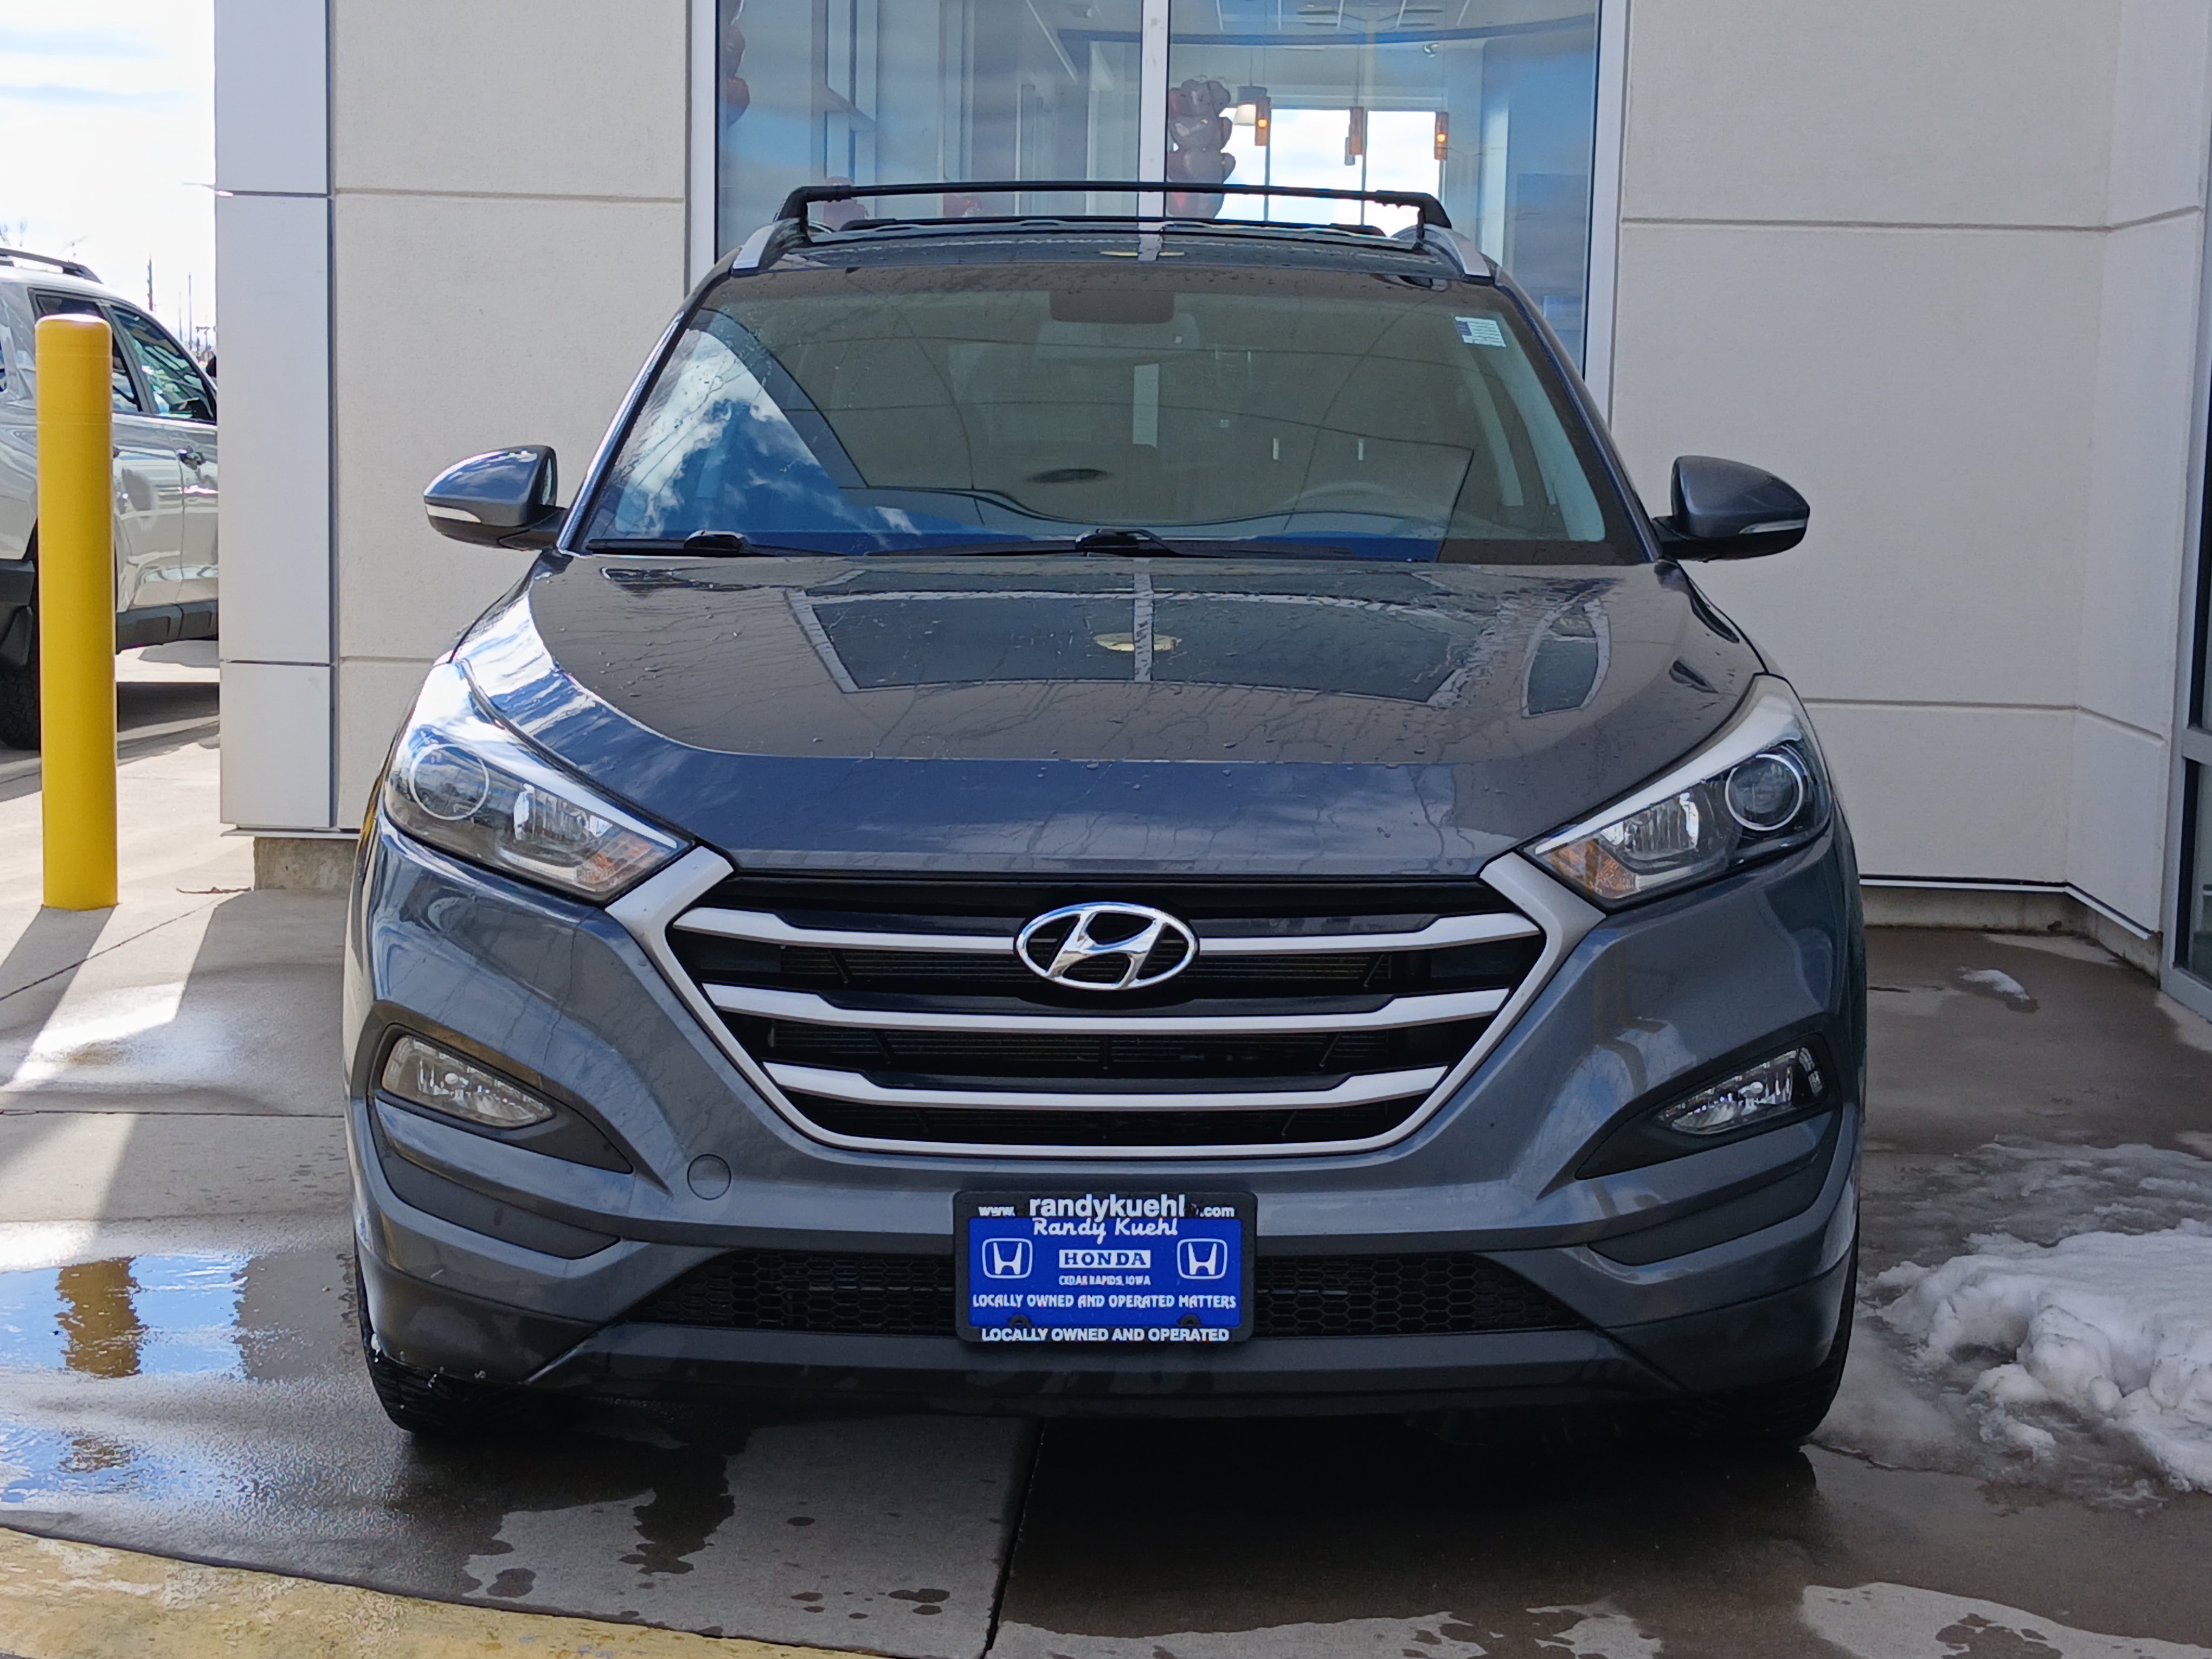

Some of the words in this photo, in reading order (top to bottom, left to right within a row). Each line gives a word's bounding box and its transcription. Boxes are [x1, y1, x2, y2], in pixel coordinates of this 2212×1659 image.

[1030, 1194, 1185, 1223] randykuehl
[1032, 1218, 1107, 1245] Randy
[1115, 1218, 1178, 1236] Kuehl
[1064, 1252, 1147, 1266] HONDA
[1126, 1275, 1151, 1285] IOWA
[972, 1294, 1024, 1308] LOCALLY
[1026, 1294, 1074, 1308] OWNED
[1077, 1294, 1105, 1309] AND
[1109, 1294, 1175, 1308] OPERATED
[1178, 1295, 1237, 1309] MATTERS
[982, 1328, 1049, 1341] LOCALLY
[1051, 1328, 1109, 1341] OWNED
[1112, 1328, 1145, 1342] AND
[1148, 1328, 1230, 1341] OPERATED
